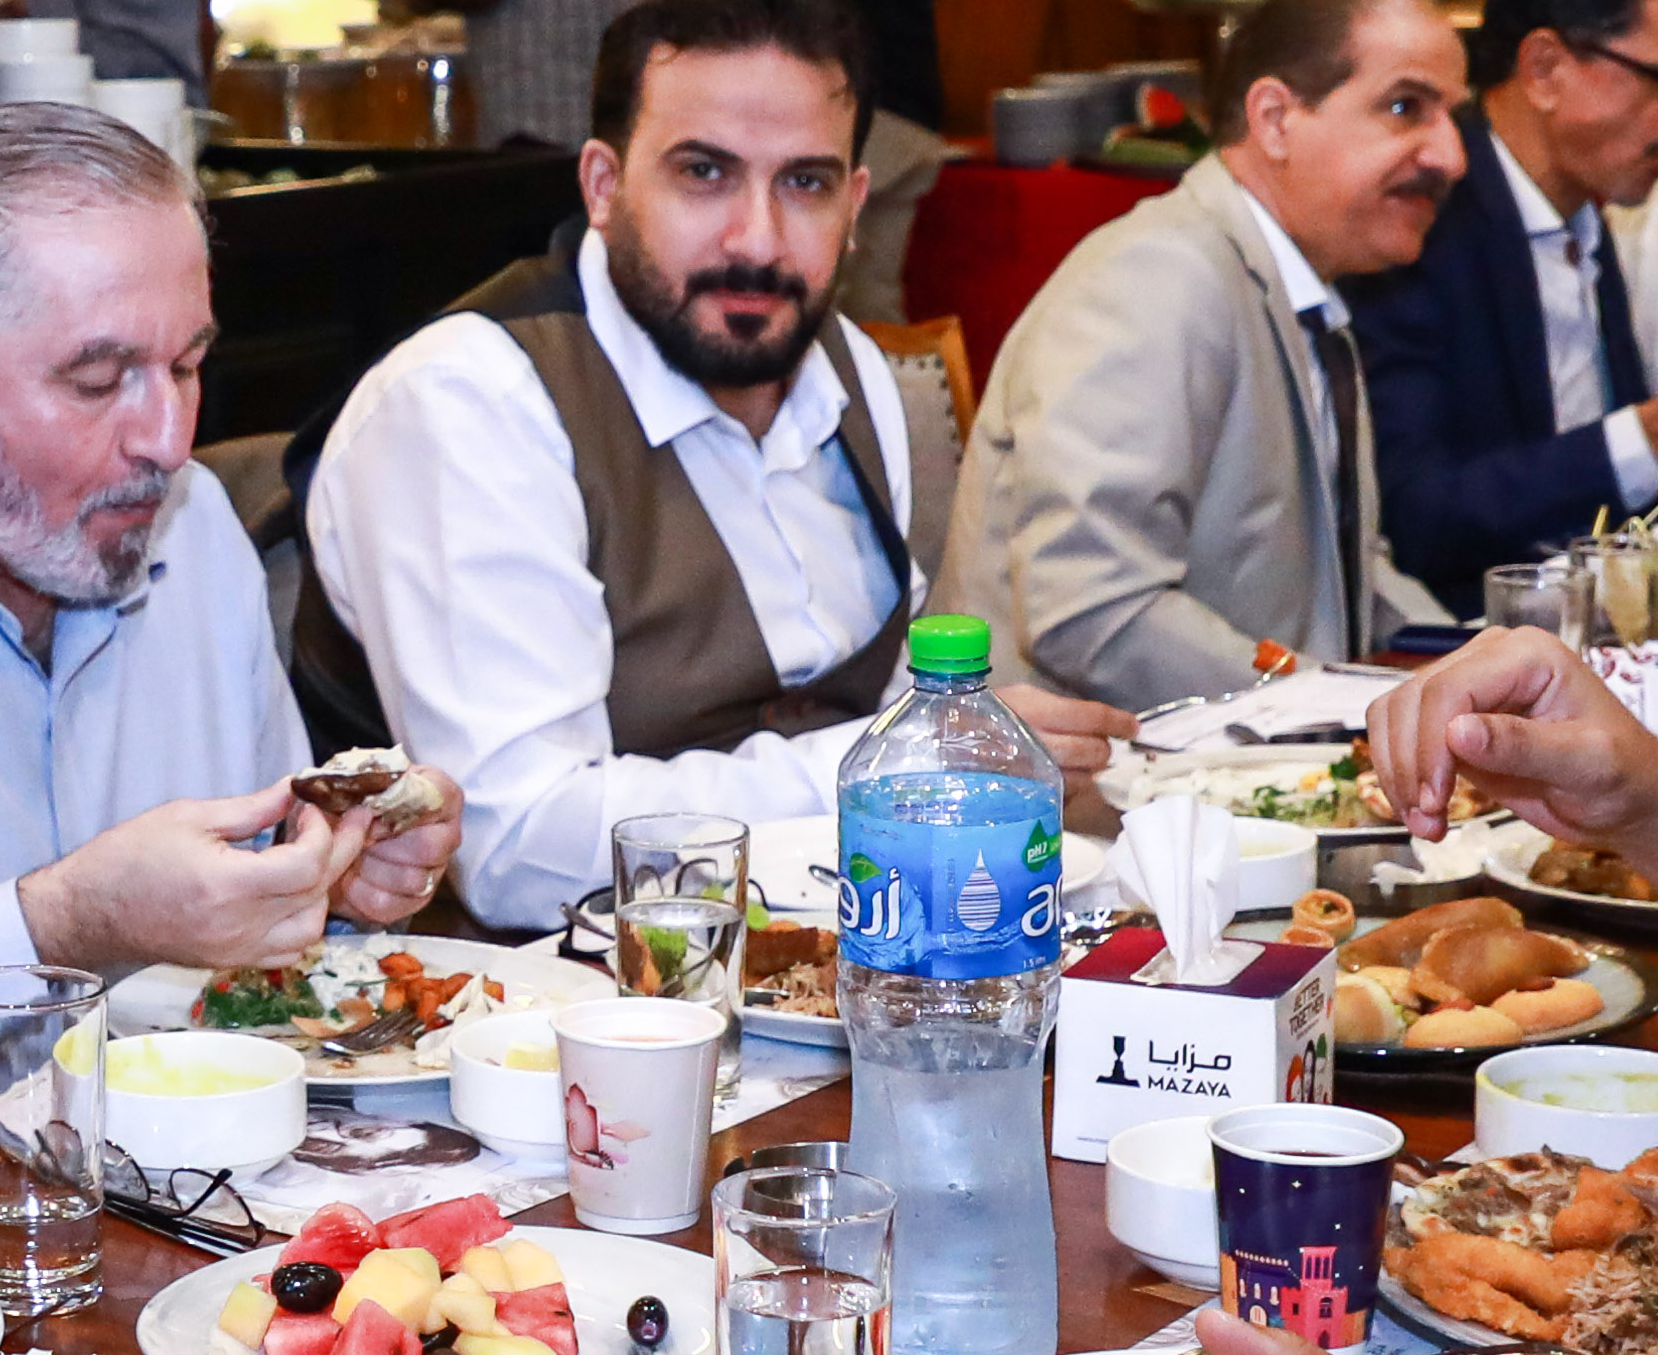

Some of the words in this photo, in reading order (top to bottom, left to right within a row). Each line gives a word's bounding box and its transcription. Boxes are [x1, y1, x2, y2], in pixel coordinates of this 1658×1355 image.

[838, 867, 901, 941] أرو
[1148, 1039, 1232, 1074] مزايا
[1147, 1075, 1232, 1099] MAZAYA
